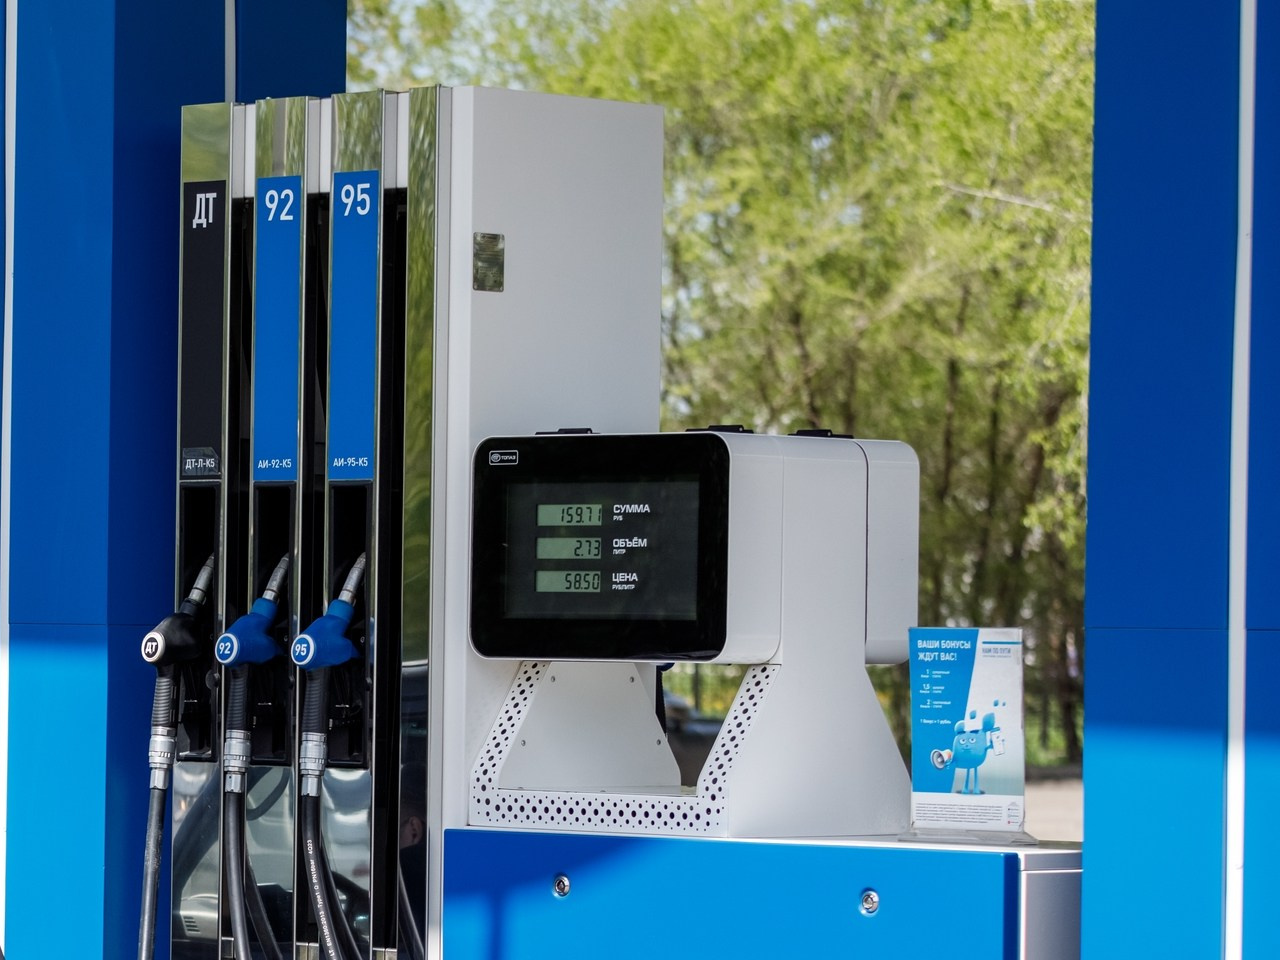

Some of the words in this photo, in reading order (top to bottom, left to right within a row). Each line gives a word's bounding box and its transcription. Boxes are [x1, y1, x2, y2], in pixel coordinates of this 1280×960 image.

[265, 188, 294, 222] 92
[341, 183, 371, 217] 95
[192, 192, 217, 229] ДТ
[185, 458, 215, 469] ДТ-Л-К5
[257, 459, 292, 469] АИ-92-К5
[333, 457, 368, 467] АИ-95-К5
[613, 504, 650, 513] СУММА
[612, 536, 648, 548] ОБЪЁМ
[574, 540, 601, 557] 2.73
[565, 573, 600, 590] 58.50
[612, 572, 638, 583] ЦЕНА
[219, 642, 231, 655] 92
[295, 643, 308, 656] 95
[917, 640, 940, 648] ВАШИ
[941, 640, 971, 649] БОНУСЫ
[918, 652, 939, 661] ЖДУТ
[940, 652, 957, 661] ВАС!
